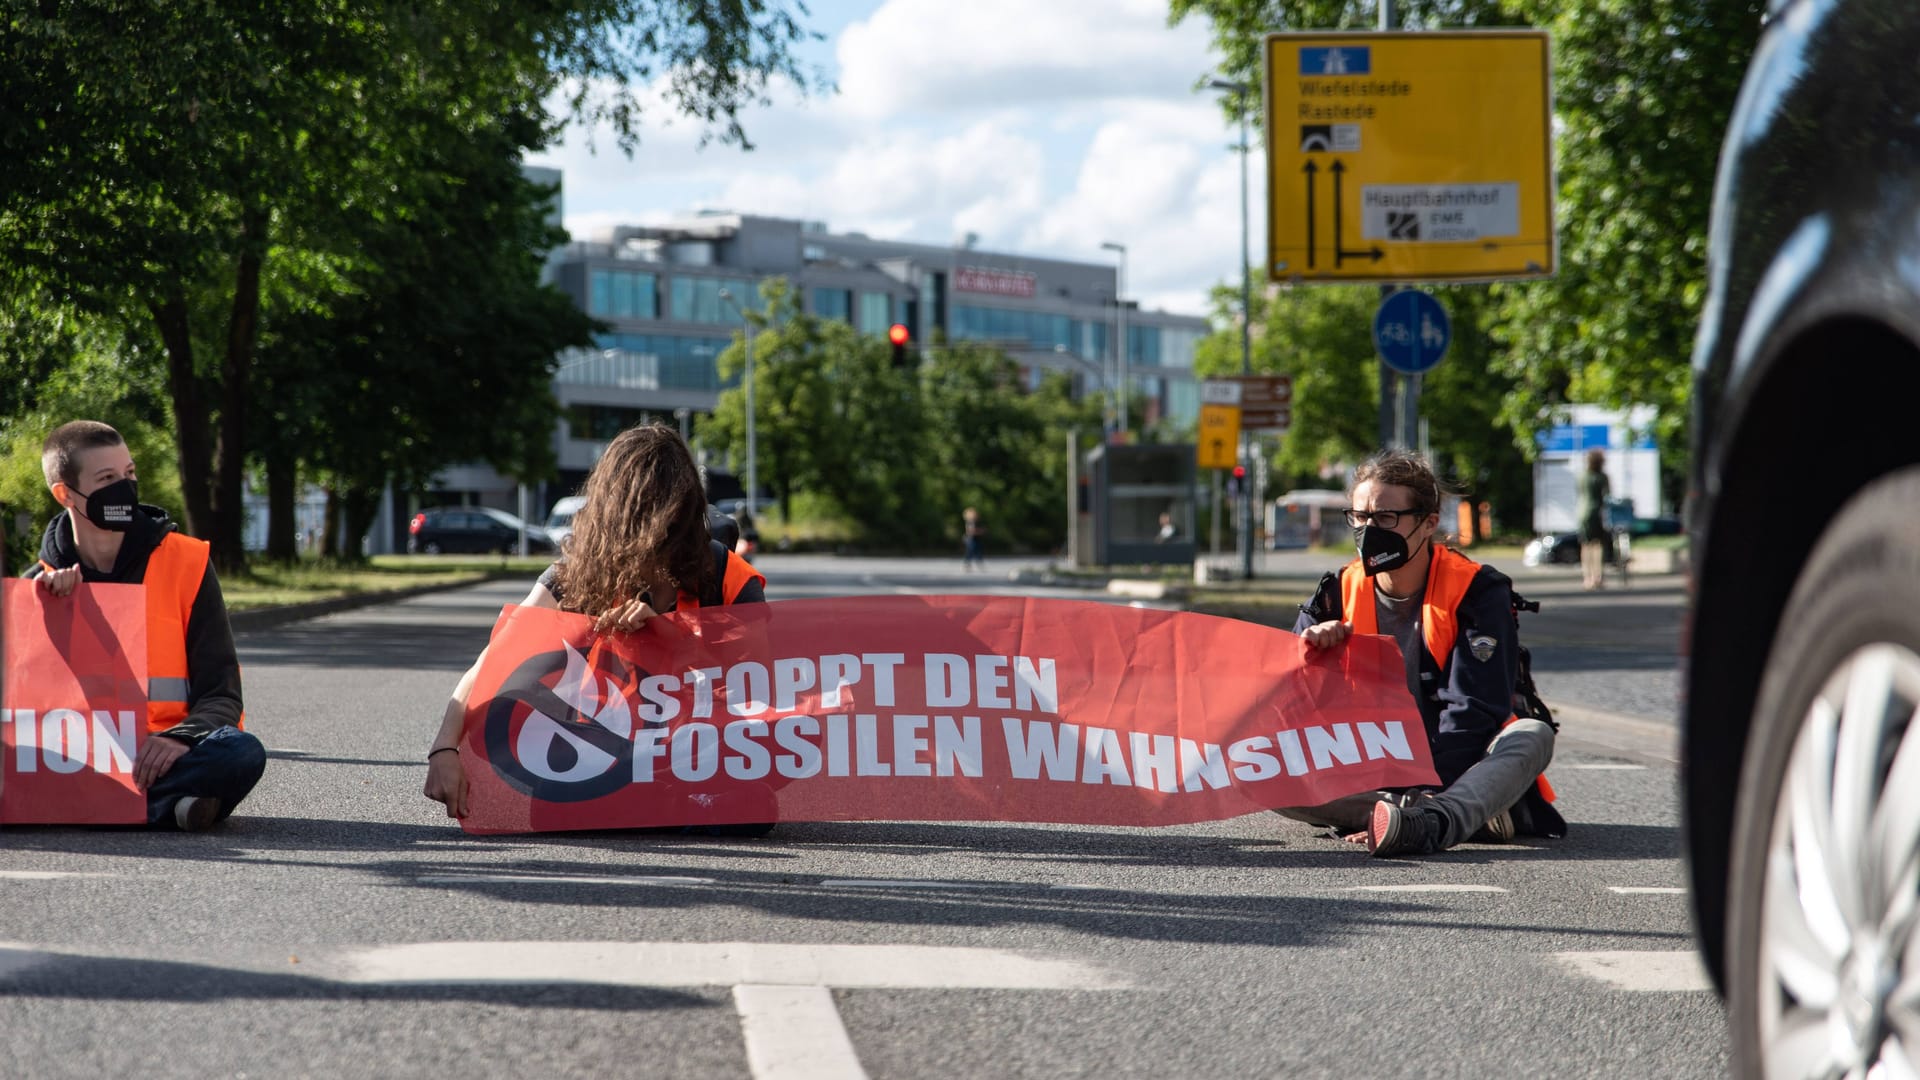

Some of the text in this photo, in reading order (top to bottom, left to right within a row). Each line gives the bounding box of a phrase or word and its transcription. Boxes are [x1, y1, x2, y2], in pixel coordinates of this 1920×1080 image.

[1299, 80, 1410, 96] Wiefelstede
[1299, 103, 1376, 119] Rastede
[1365, 188, 1499, 208] Hauptbahnhof
[638, 653, 1058, 723] STOPPT DEN
[632, 714, 1414, 793] FOSSILEN WAHNSINN
